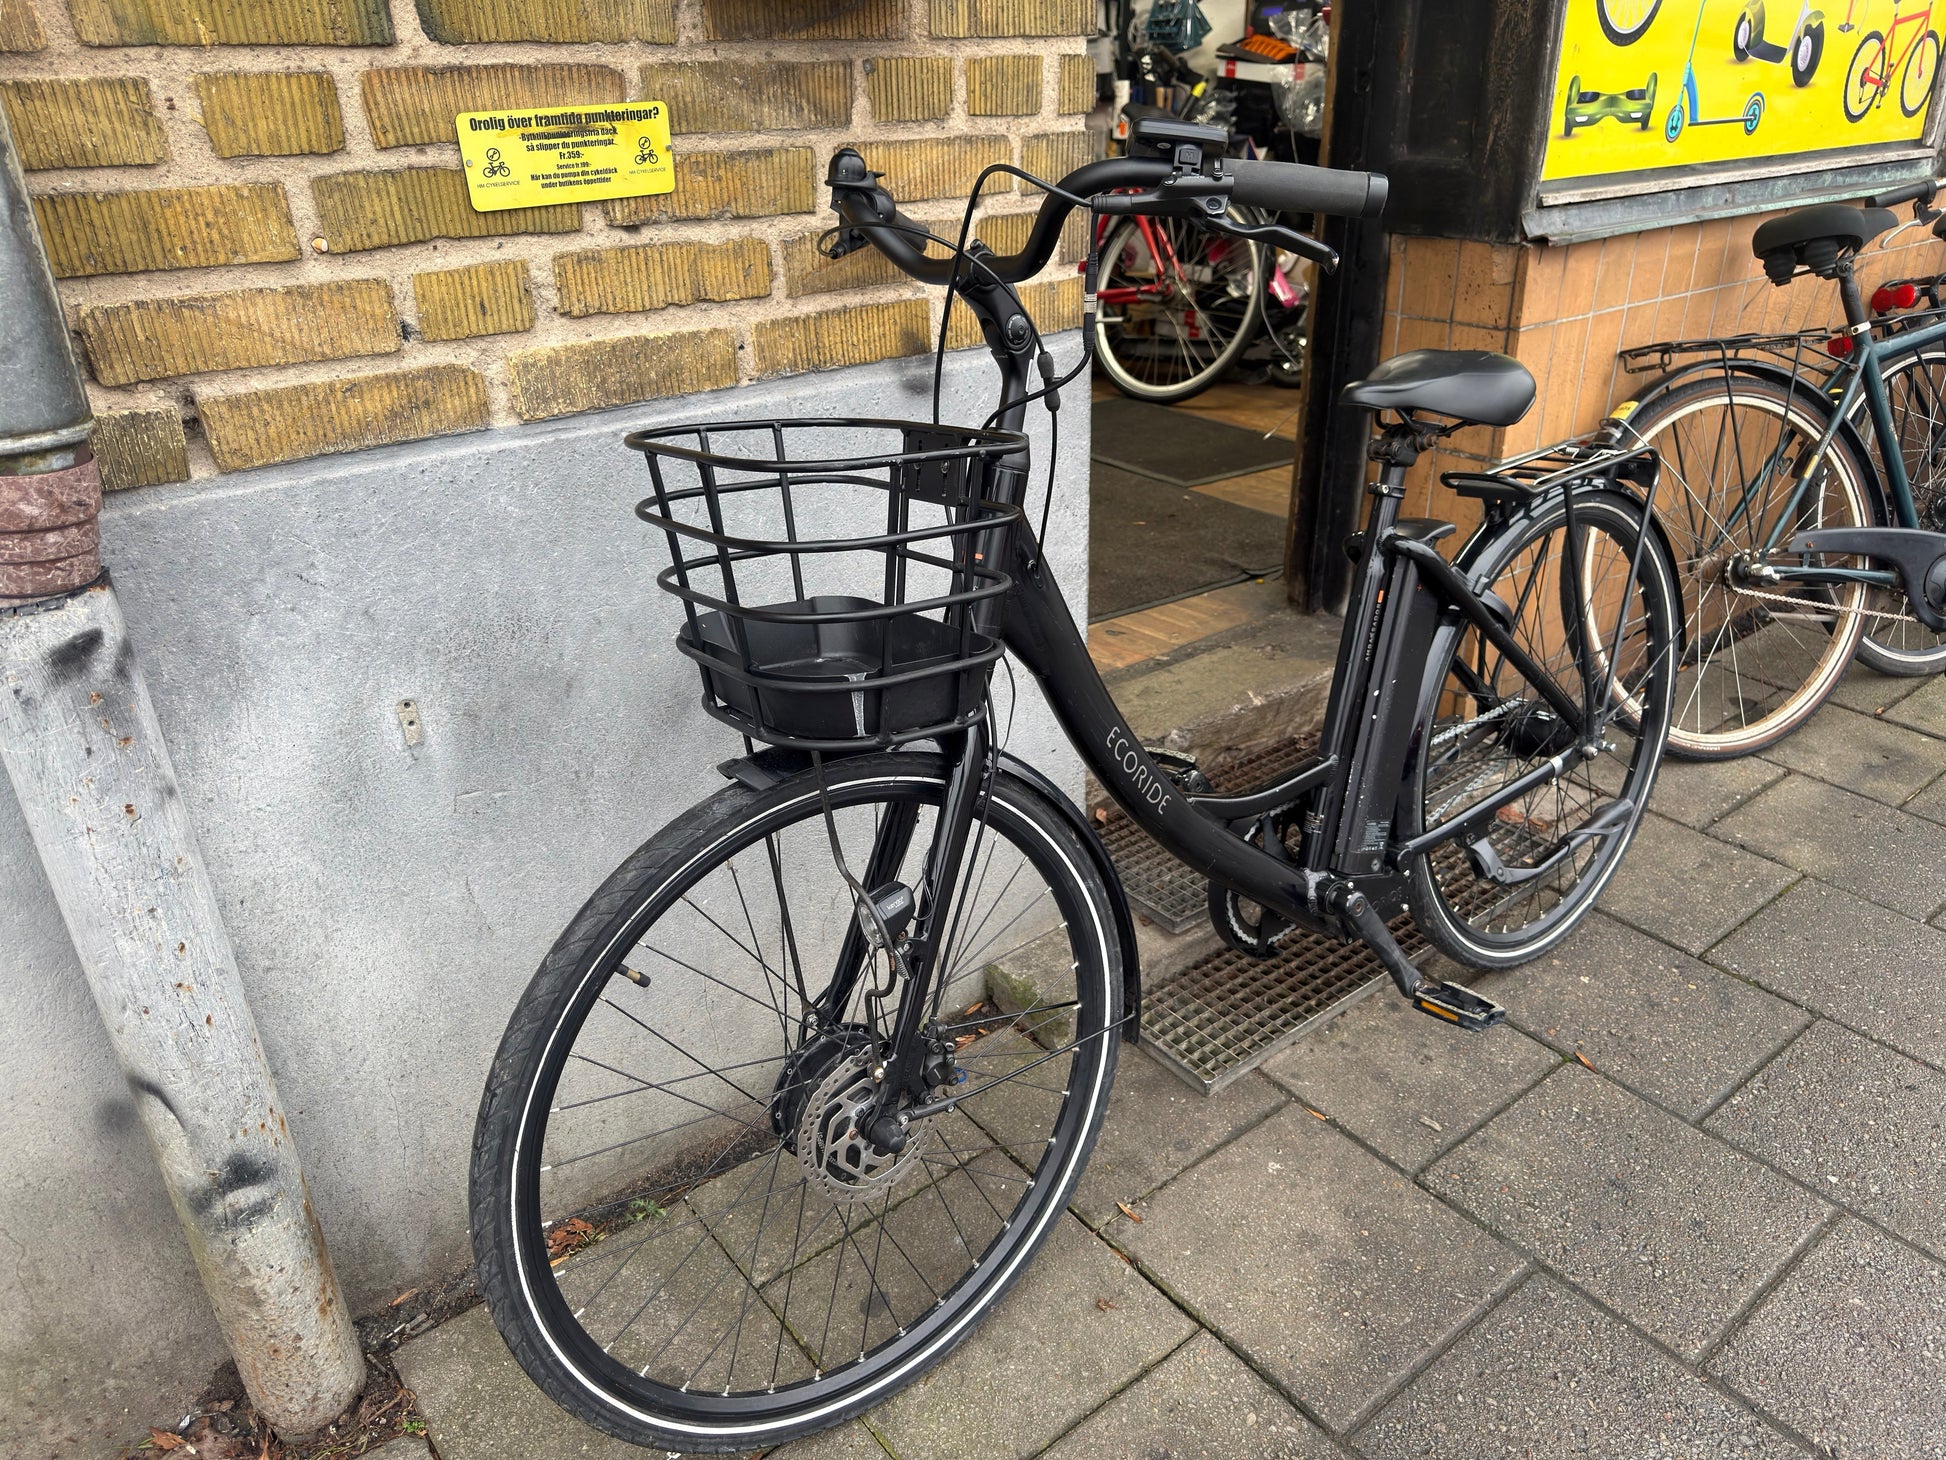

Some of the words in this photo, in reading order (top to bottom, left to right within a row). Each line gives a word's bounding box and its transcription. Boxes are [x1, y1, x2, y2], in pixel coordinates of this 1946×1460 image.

[469, 116, 506, 131] Orolig
[507, 115, 532, 129] över
[534, 111, 582, 127] framtida
[585, 106, 659, 125] punkteringar?
[526, 142, 535, 152] så
[536, 142, 560, 152] slipper
[561, 141, 570, 149] du
[556, 162, 575, 170] Service
[530, 173, 541, 181] Här
[541, 172, 552, 181] kan
[553, 172, 560, 180] du
[561, 171, 580, 180] pumpa
[580, 169, 590, 177] din
[590, 167, 618, 176] cykeldäck
[541, 181, 558, 189] under
[558, 178, 583, 188] butikens
[583, 176, 612, 186] öppettider
[1106, 726, 1172, 815] ECORIDE
